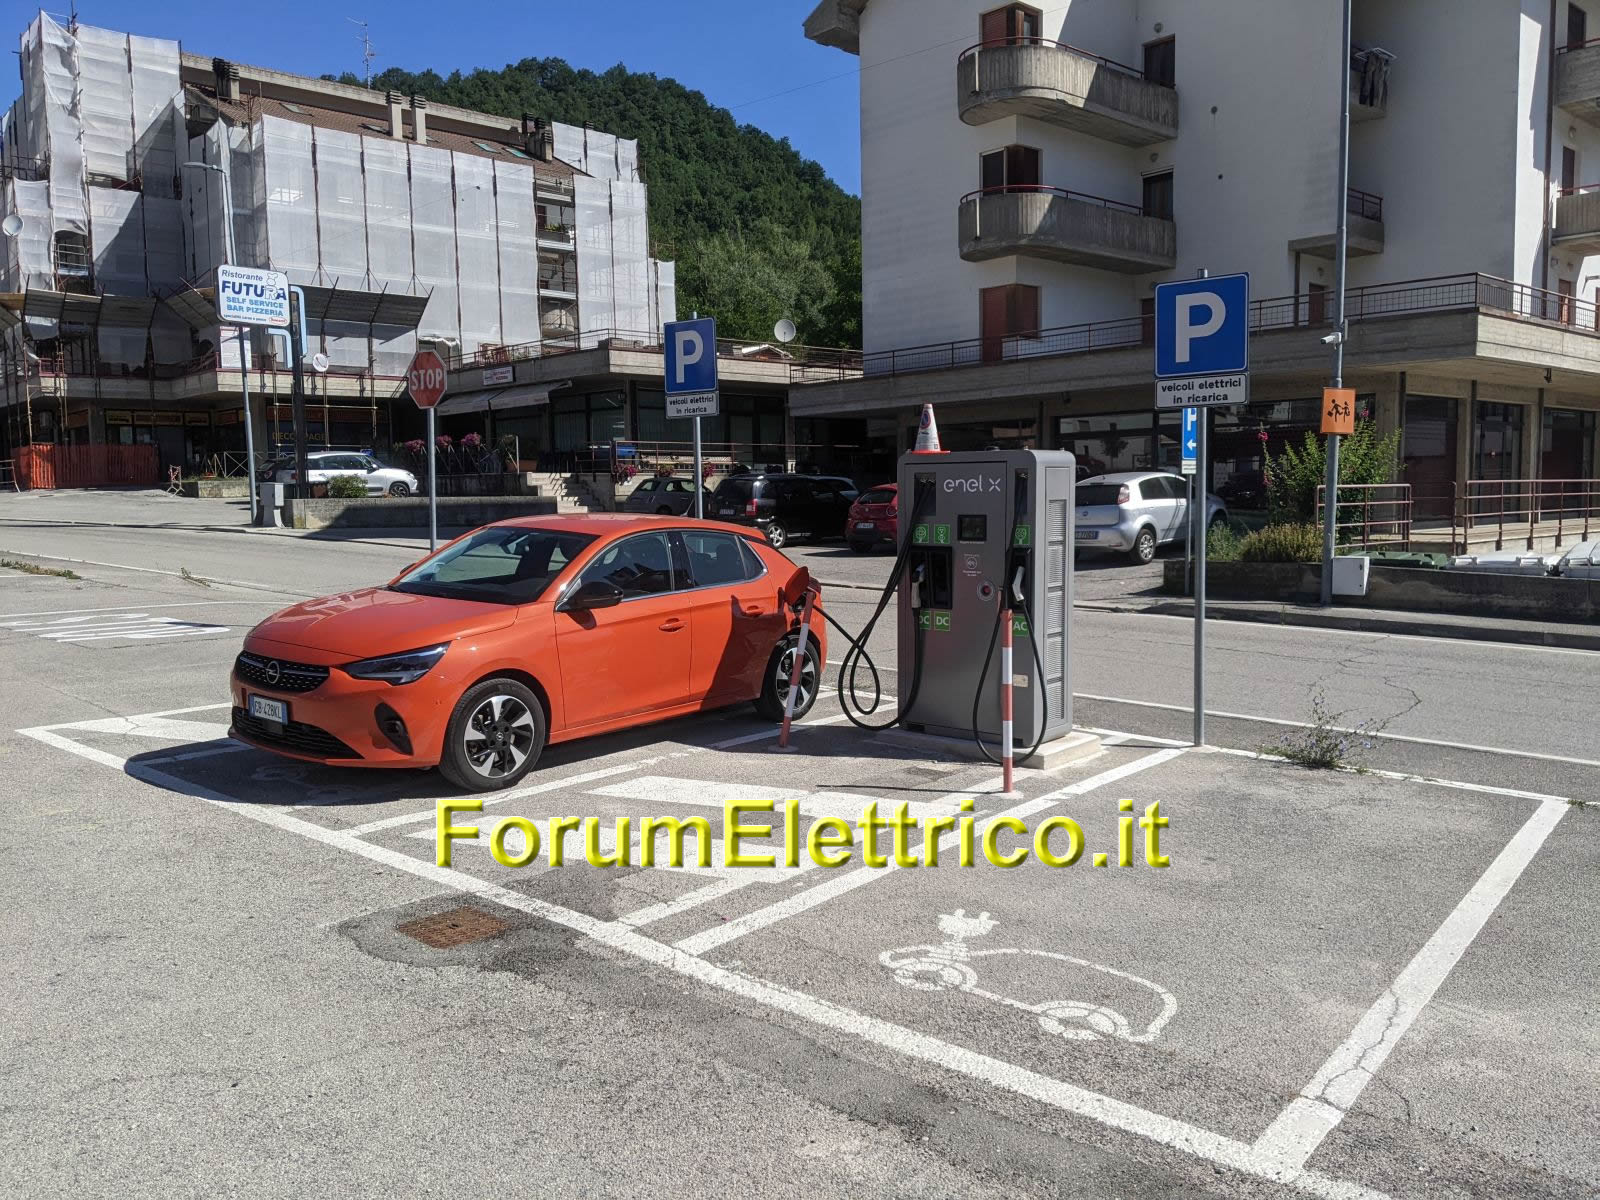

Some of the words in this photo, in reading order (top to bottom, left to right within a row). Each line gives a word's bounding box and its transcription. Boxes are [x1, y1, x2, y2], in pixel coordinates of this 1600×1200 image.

[221, 269, 264, 282] Ristorante
[221, 280, 287, 300] FUTURA
[226, 296, 246, 304] SELF
[249, 299, 284, 309] SERVICE
[226, 304, 244, 313] BAR
[246, 306, 284, 317] PIZZERIA
[1175, 291, 1226, 363] P
[675, 330, 704, 384] P
[410, 367, 443, 392] STOP
[1161, 381, 1194, 392] veicoli
[1198, 377, 1242, 390] elettrici
[669, 397, 688, 406] veicoli
[690, 395, 714, 404] elettrici
[1173, 395, 1183, 404] in
[1187, 392, 1229, 404] ricarica
[684, 405, 707, 414] ricarica
[943, 474, 983, 492] enel
[935, 616, 950, 626] DC
[1012, 621, 1028, 631] AC
